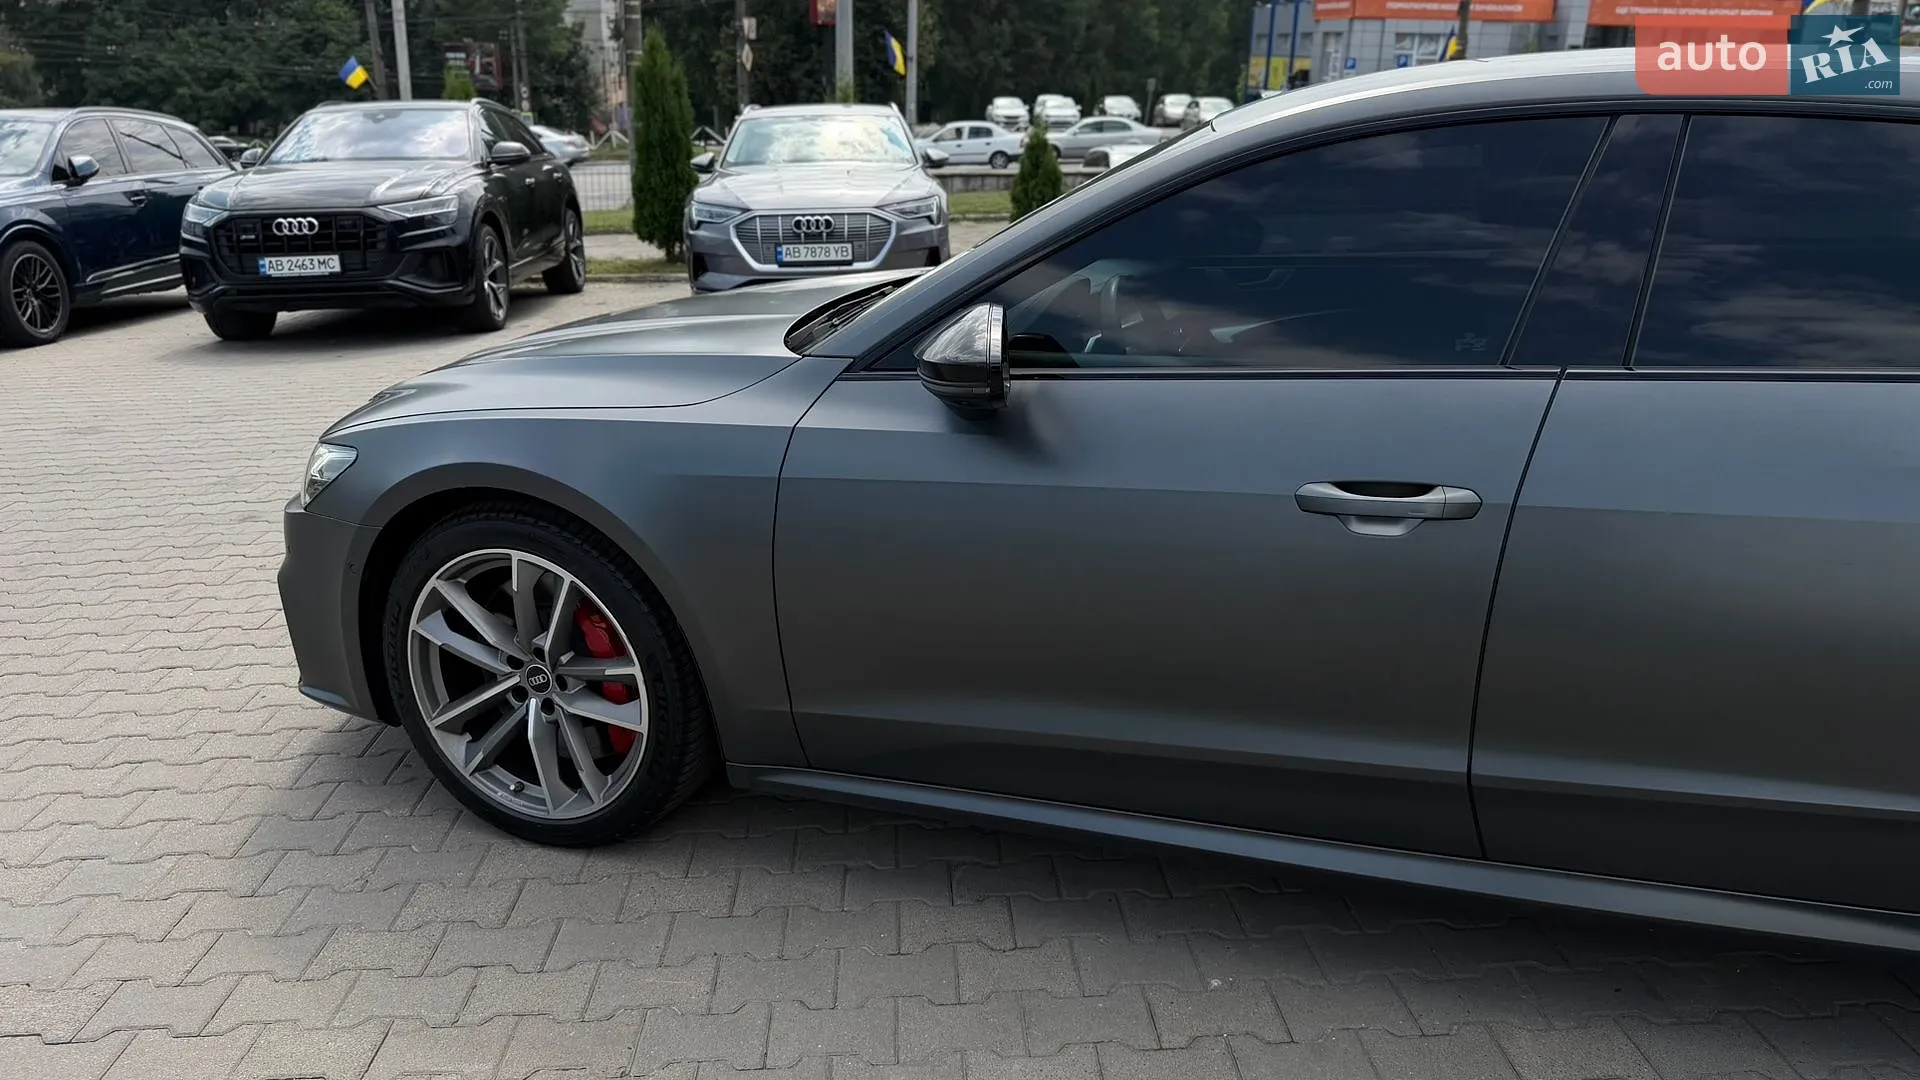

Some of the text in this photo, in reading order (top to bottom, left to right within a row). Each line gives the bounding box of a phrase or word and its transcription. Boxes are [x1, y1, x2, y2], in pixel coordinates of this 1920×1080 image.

[785, 246, 849, 259] AB 7878 YB
[268, 257, 335, 272] AB 2463 MC
